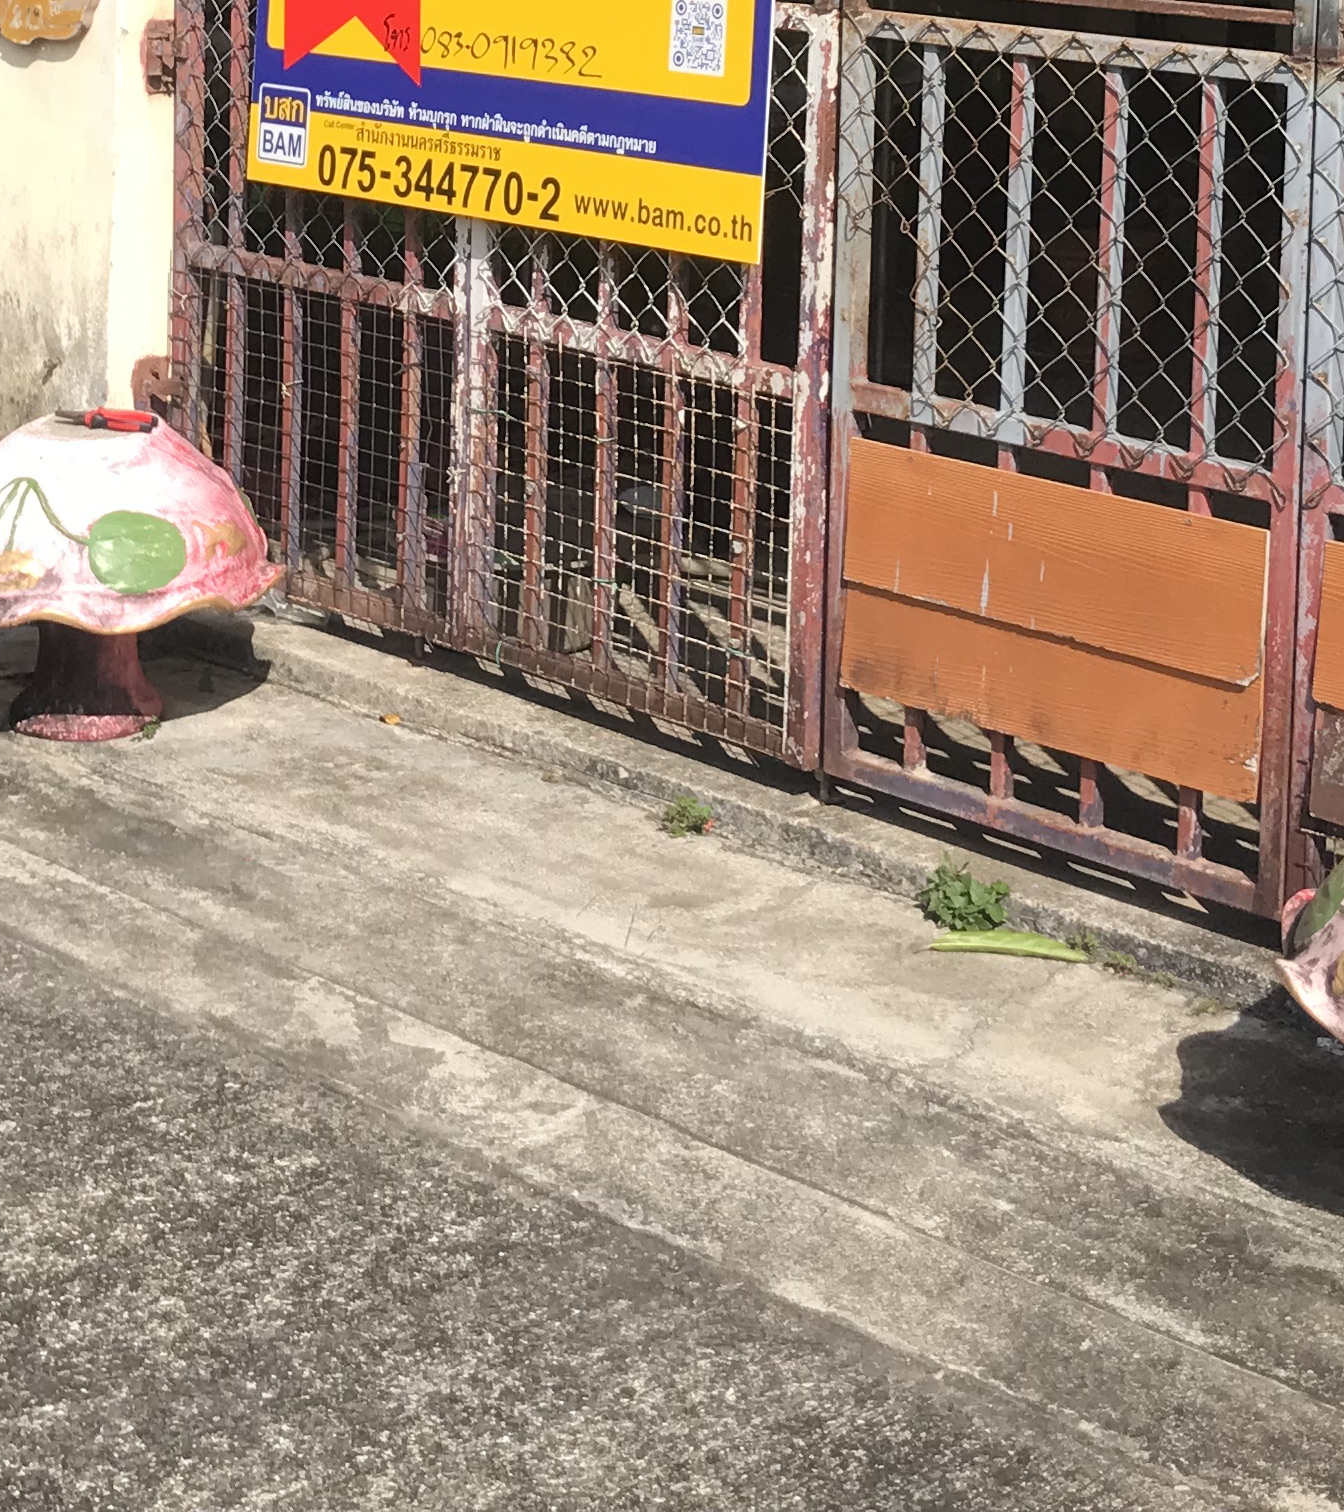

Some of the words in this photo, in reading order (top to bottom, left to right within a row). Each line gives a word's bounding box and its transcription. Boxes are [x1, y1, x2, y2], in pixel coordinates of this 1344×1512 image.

[264, 94, 304, 123] บสก
[315, 91, 404, 118] ทรัพย์สินของบริษัท
[408, 101, 457, 130] ห้ามบุกรุก
[460, 113, 657, 155] หากฝ่าฝืนจะถูกดำเนินคดีตามกฎหมาย
[262, 129, 302, 159] BAM
[356, 121, 502, 162] สำนักงานนครศรีธรรมราช
[318, 144, 562, 222] 075-344770-2
[574, 194, 753, 242] www.bam.co.th
